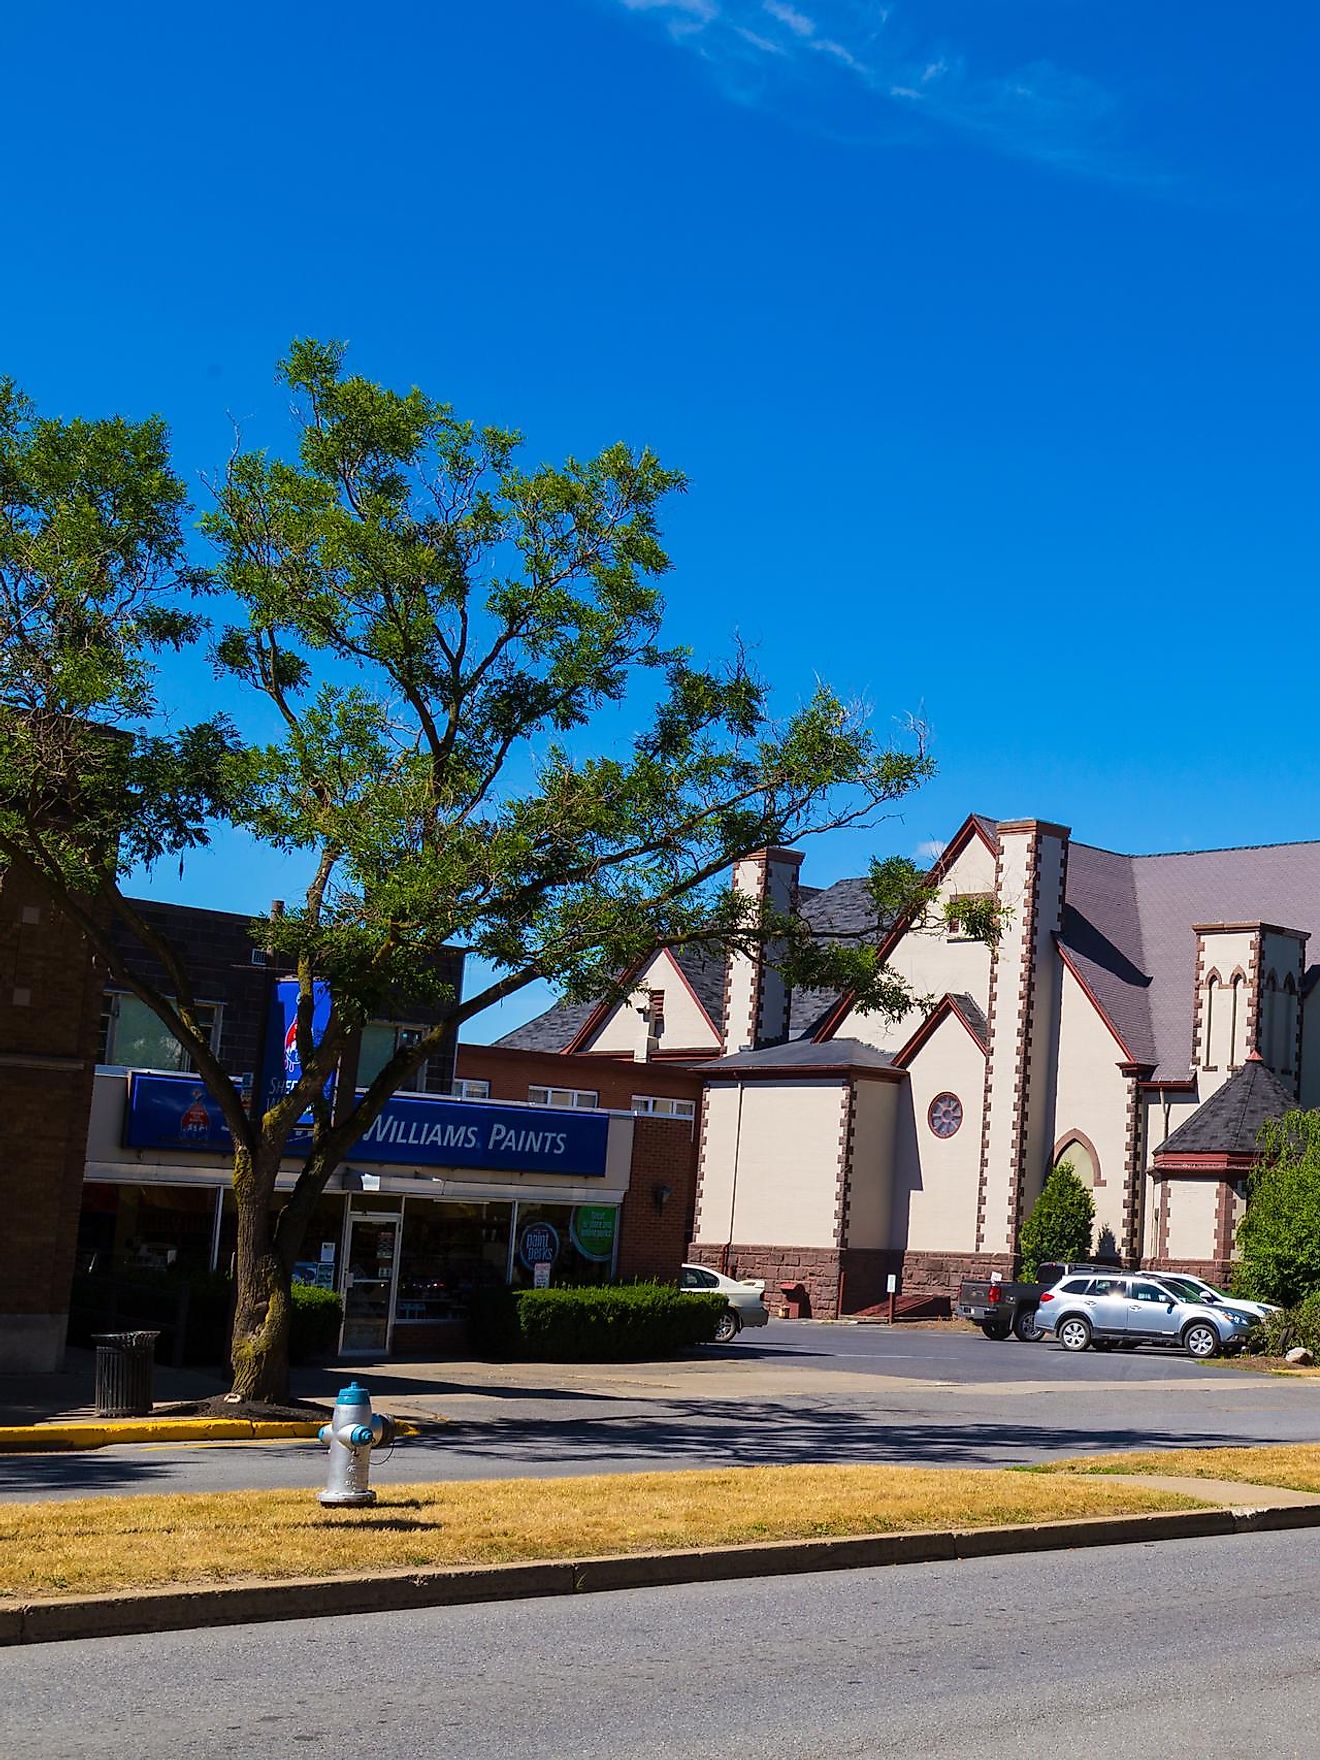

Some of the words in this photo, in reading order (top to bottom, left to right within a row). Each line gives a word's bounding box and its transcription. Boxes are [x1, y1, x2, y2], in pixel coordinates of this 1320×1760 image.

[488, 1124, 567, 1154] PAINTS
[526, 1232, 549, 1248] paint
[528, 1247, 553, 1261] perks
